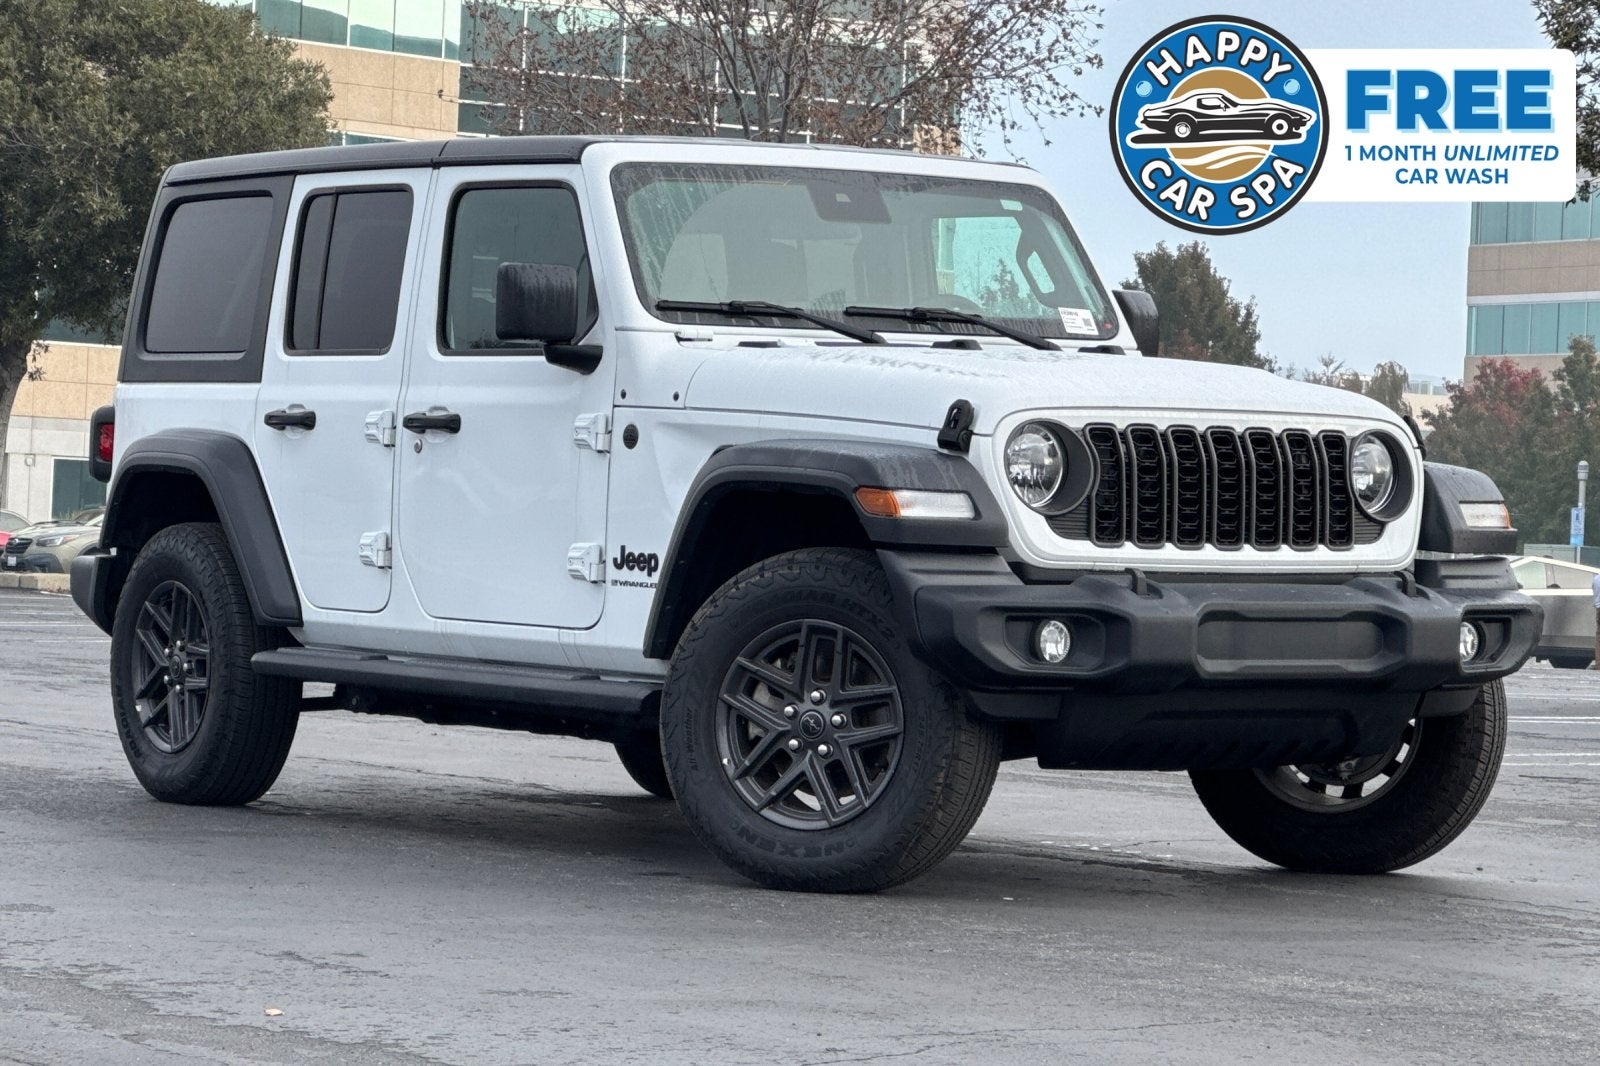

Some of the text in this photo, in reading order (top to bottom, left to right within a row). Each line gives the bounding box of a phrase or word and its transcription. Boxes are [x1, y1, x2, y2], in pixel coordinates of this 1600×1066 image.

[612, 545, 659, 577] Jeep
[618, 580, 657, 588] WRANGLE
[738, 825, 844, 857] NEXEN
